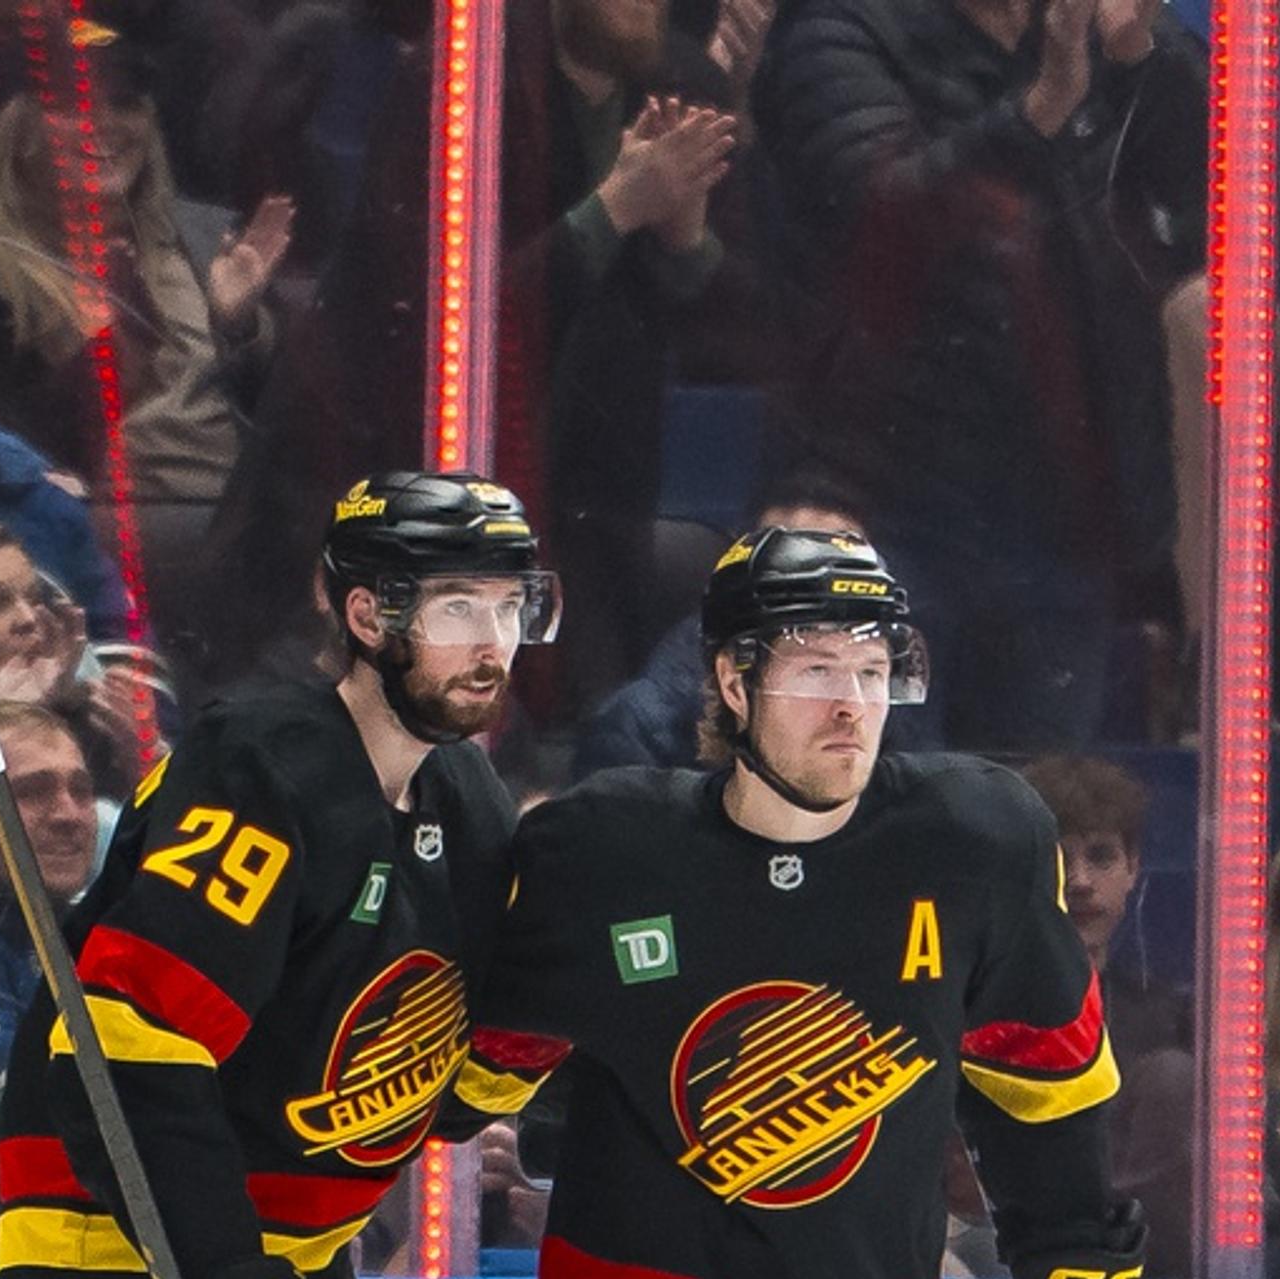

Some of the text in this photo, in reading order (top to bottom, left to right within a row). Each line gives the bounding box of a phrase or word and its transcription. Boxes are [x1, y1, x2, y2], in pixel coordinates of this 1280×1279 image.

[831, 579, 888, 596] CCM
[142, 805, 291, 927] 29
[618, 929, 669, 971] TD
[899, 898, 946, 983] A
[677, 1051, 937, 1198] CANUCKS
